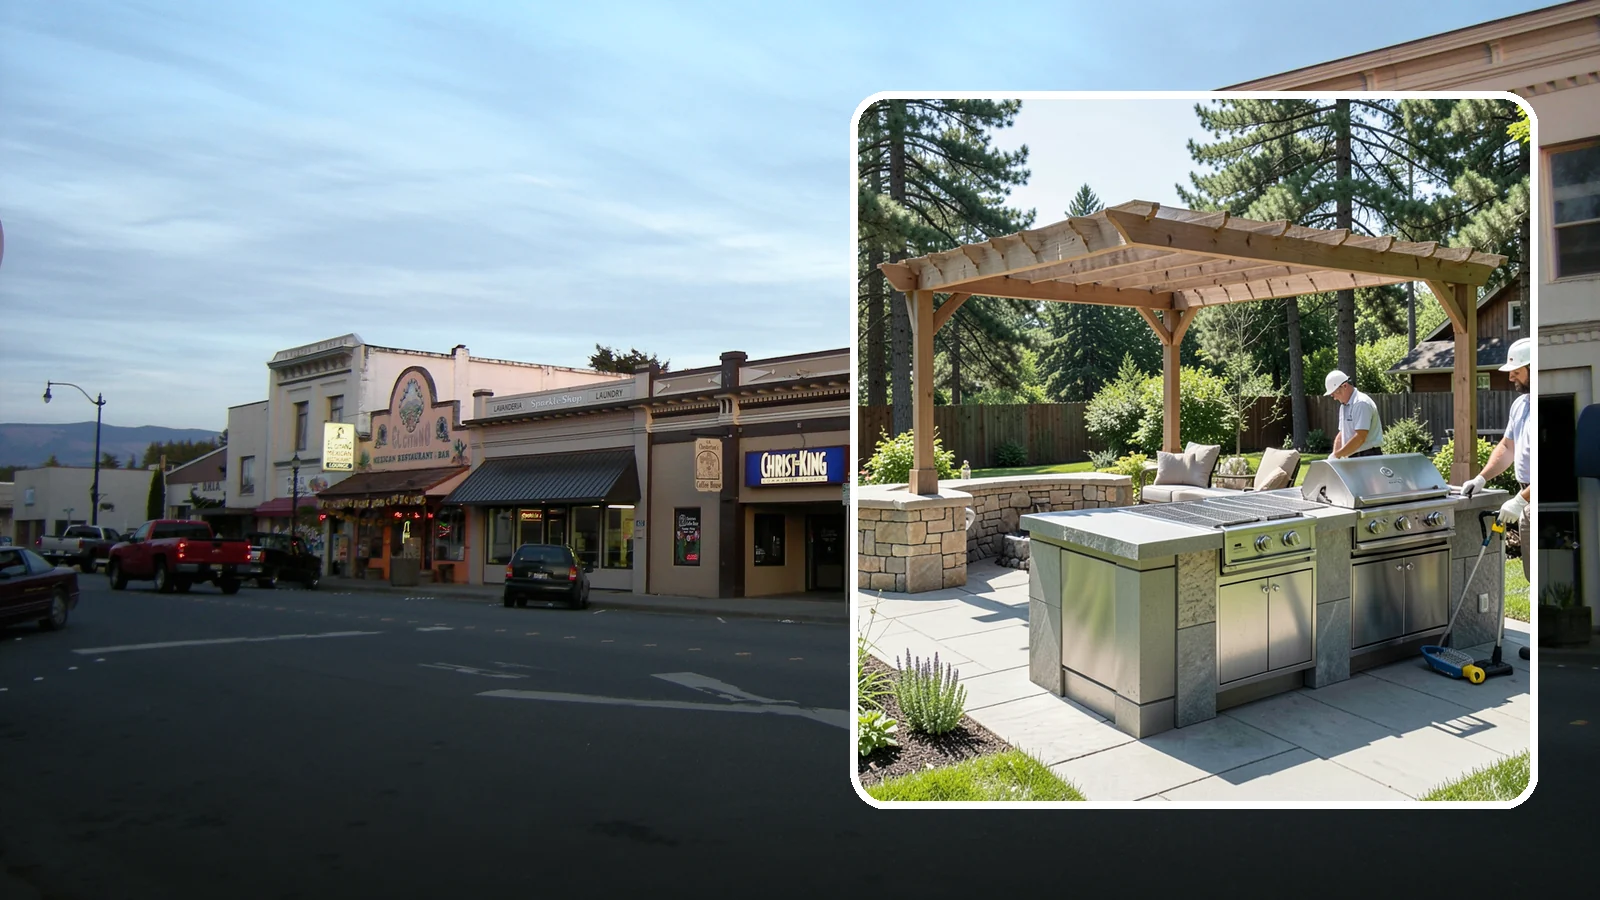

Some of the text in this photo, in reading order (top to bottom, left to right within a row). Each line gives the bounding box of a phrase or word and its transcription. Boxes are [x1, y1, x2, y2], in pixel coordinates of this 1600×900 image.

[595, 389, 624, 400] LAUNDRY
[493, 402, 523, 413] LAVANDERIA
[531, 394, 583, 409] Sparkle Shop
[373, 450, 450, 464] MEXICAN RESTAURANT BAR
[761, 450, 827, 478] CHRIST KING
[697, 481, 722, 489] Coffee House
